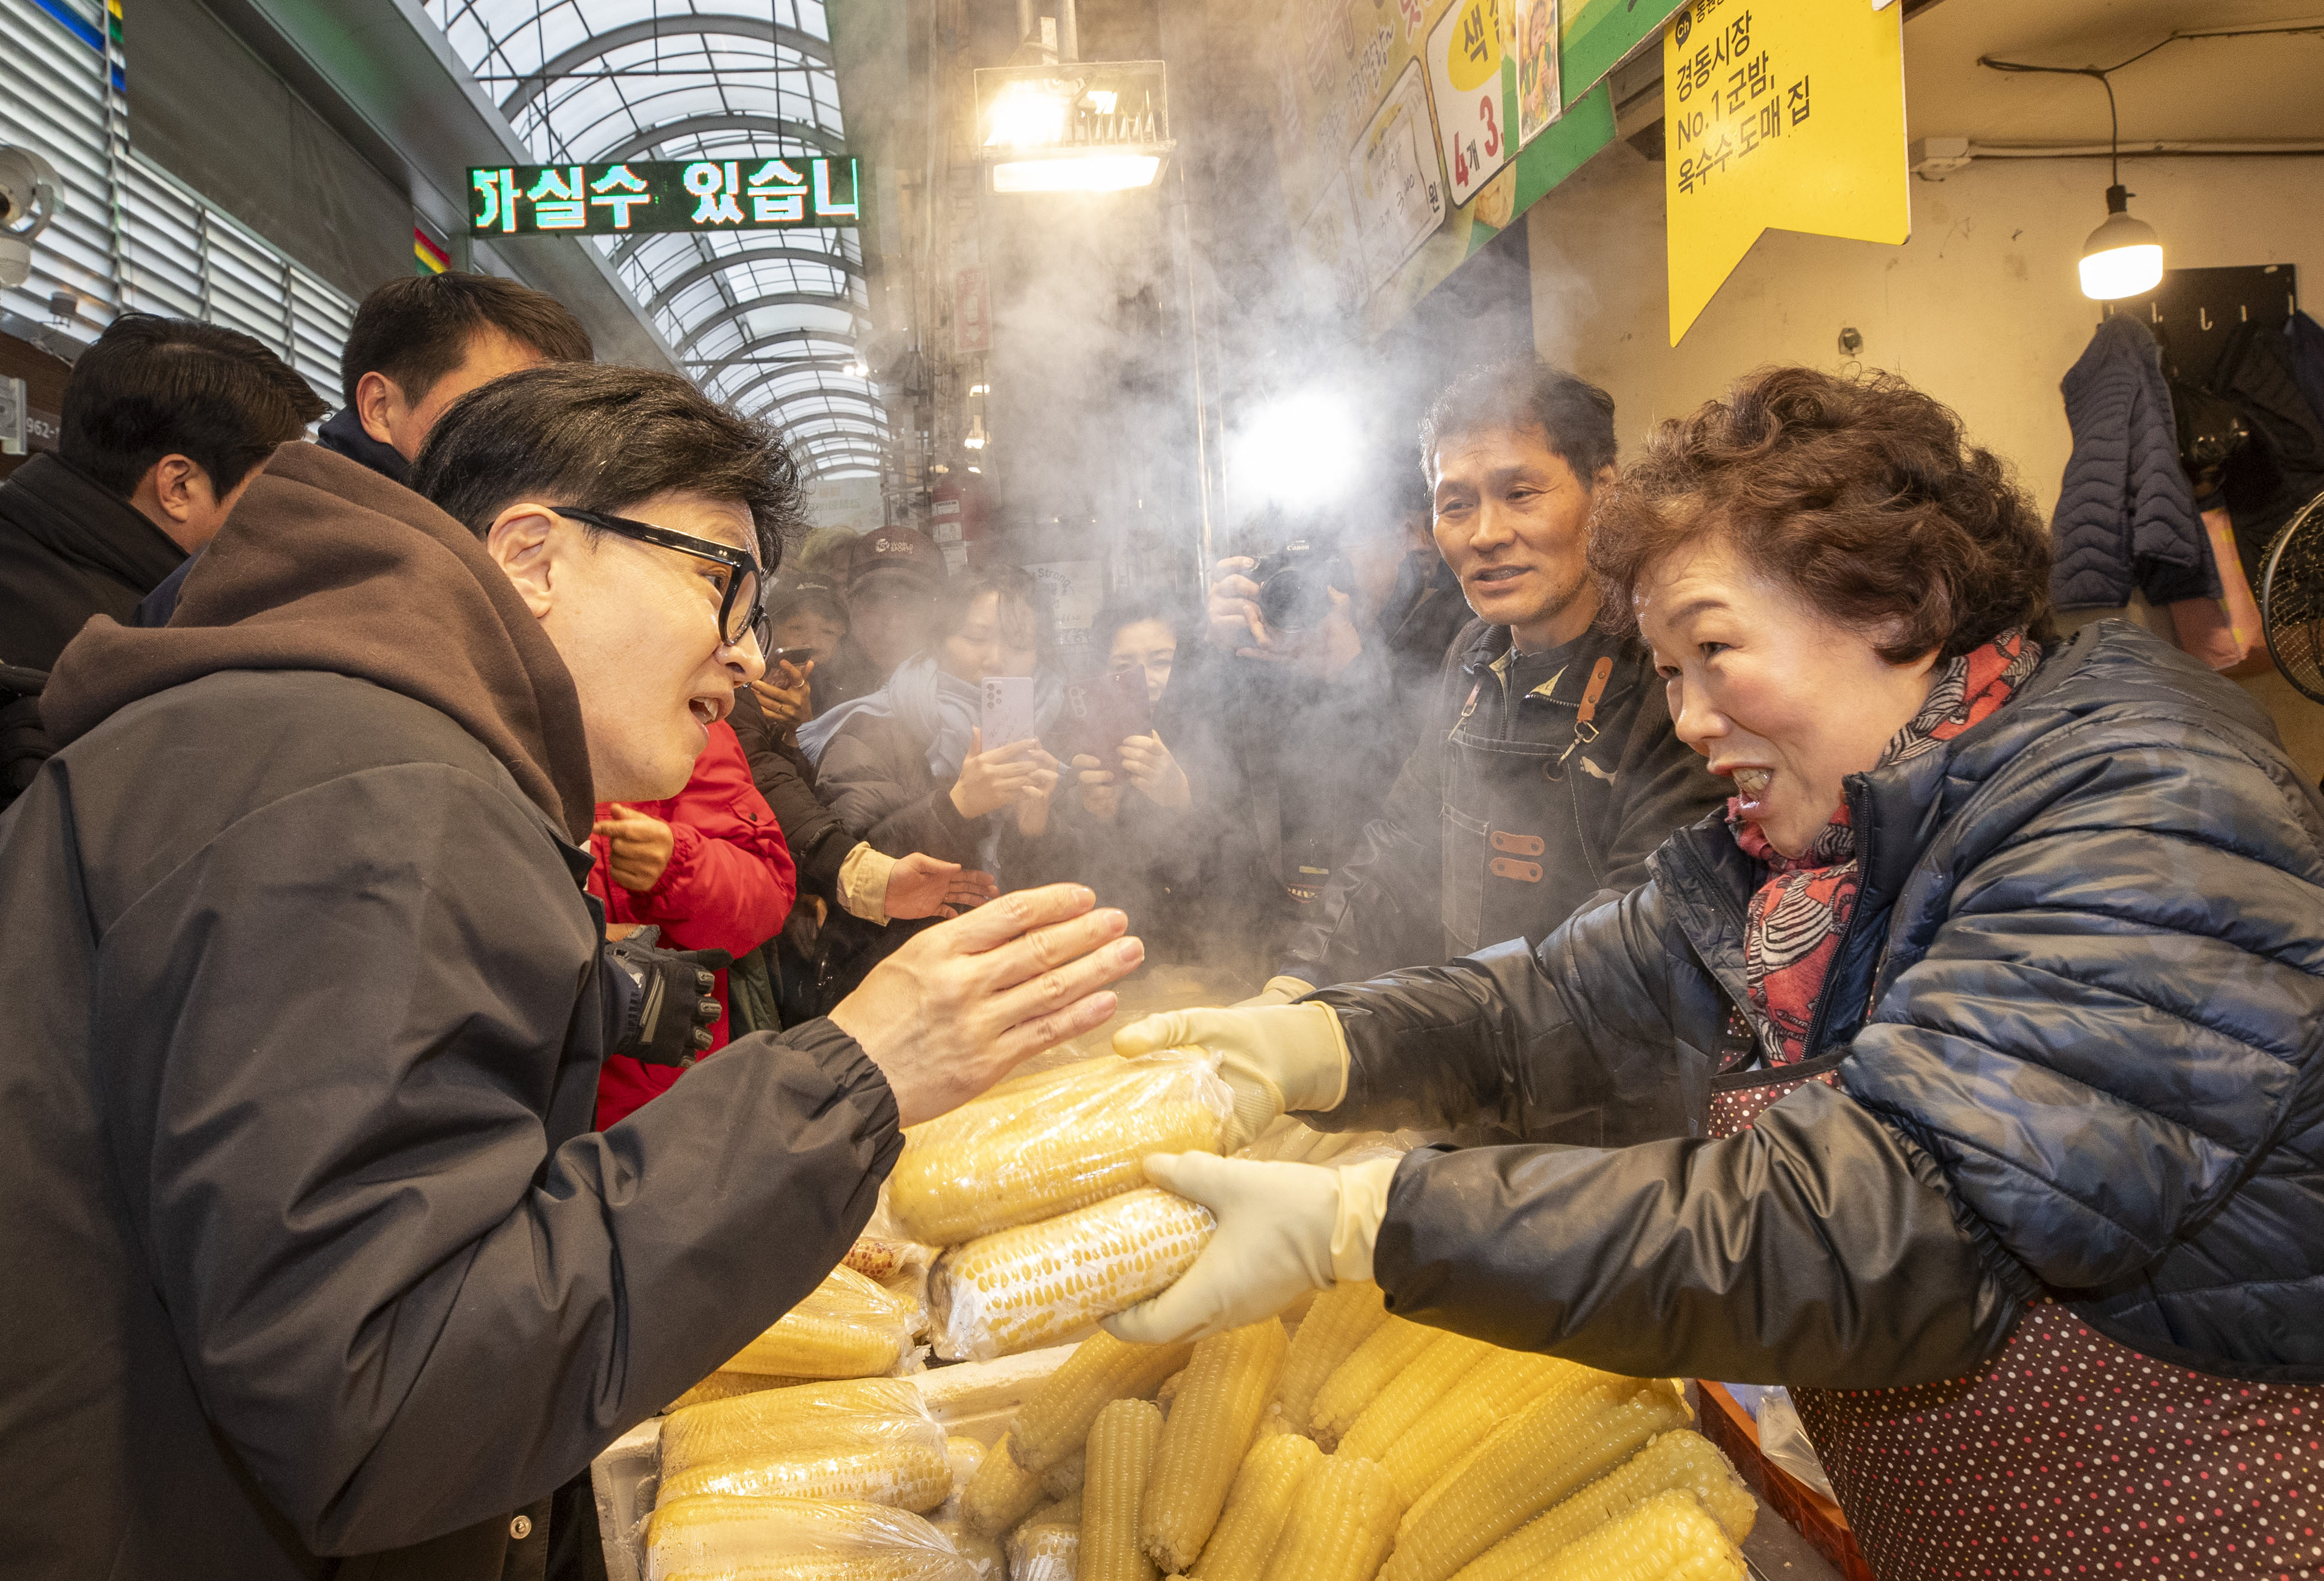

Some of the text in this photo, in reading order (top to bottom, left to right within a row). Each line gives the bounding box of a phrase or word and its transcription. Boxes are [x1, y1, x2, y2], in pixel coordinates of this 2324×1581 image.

[1677, 9, 1752, 103] 경동시장
[1726, 50, 1775, 116] 군밤,
[1480, 95, 1504, 158] 3
[1678, 135, 1733, 194] 옥수수
[1787, 75, 1811, 127] 집
[1428, 181, 1441, 214] 원
